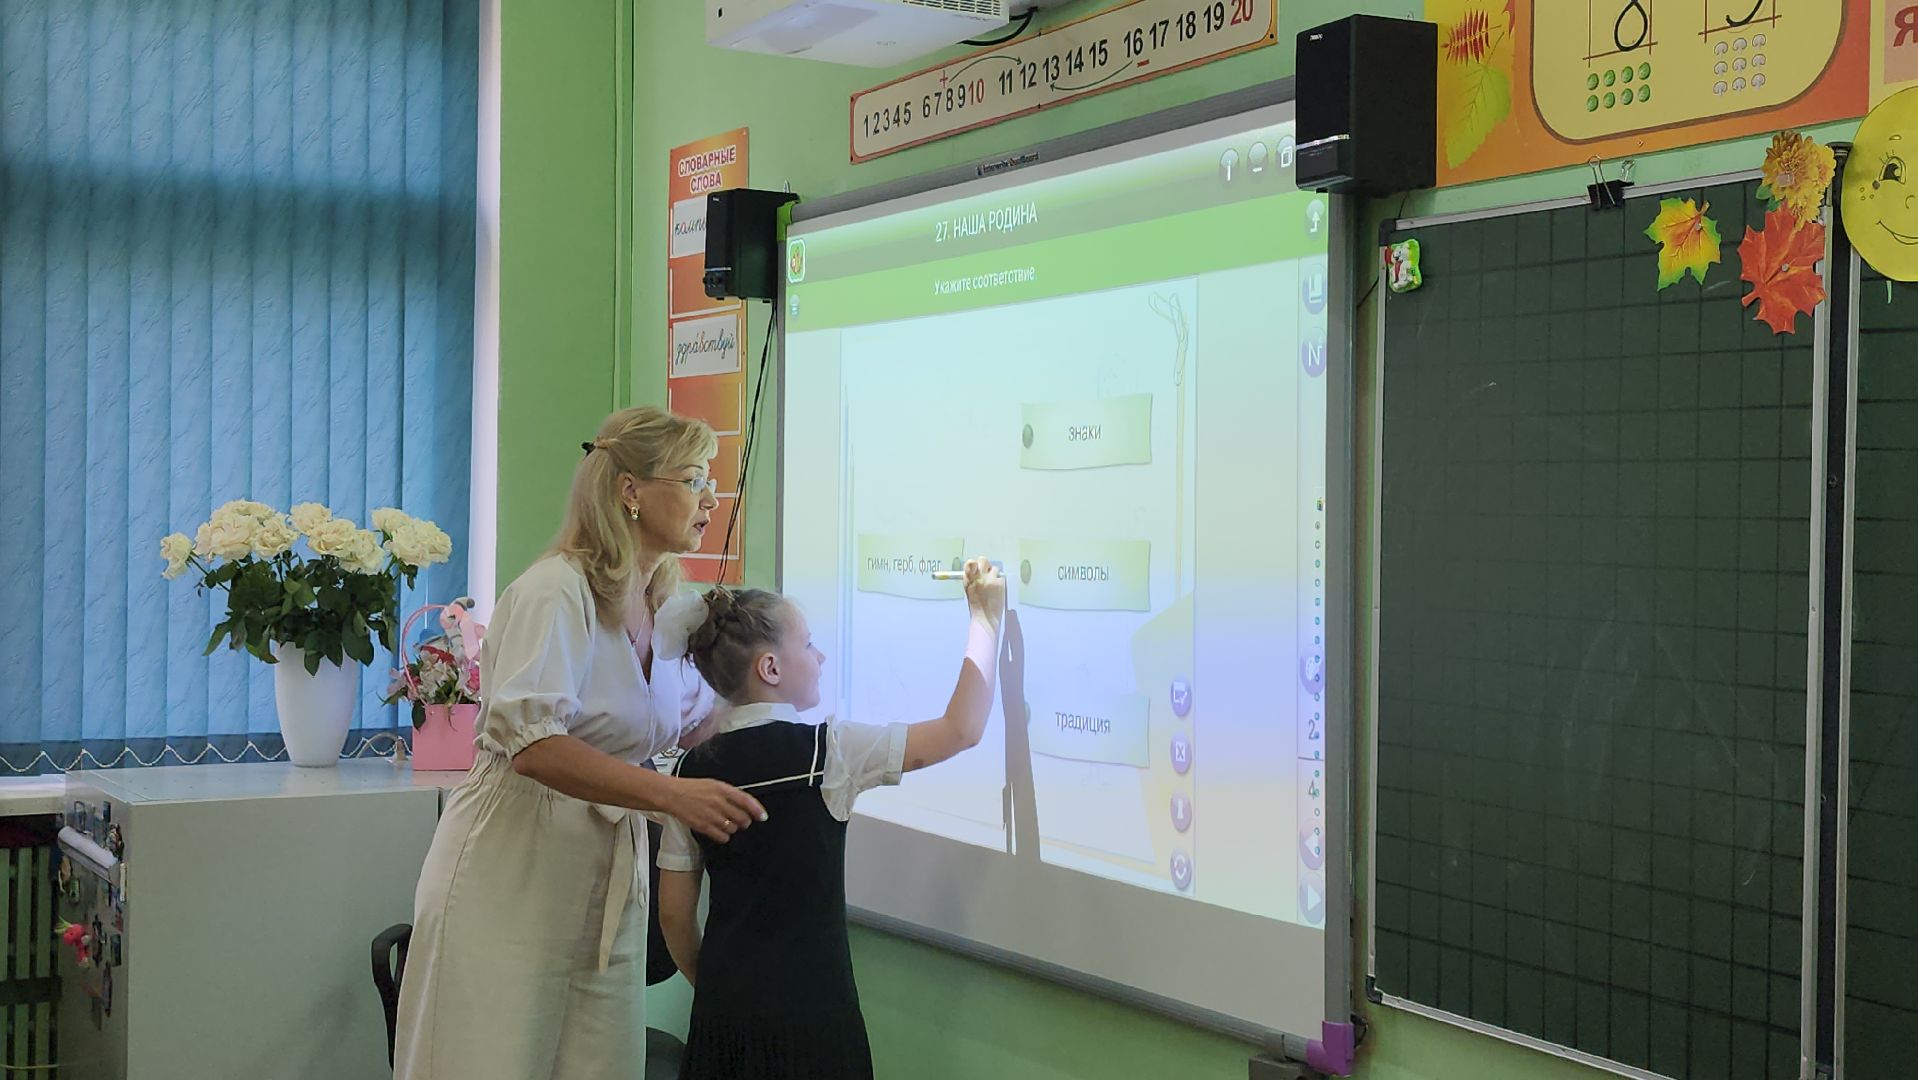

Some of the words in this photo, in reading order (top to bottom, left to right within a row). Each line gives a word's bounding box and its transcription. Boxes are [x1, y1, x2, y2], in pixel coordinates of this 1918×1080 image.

[968, 78, 985, 105] 10
[998, 69, 1013, 95] 11
[1019, 62, 1037, 90] 12
[1042, 55, 1060, 83] 13
[1065, 46, 1084, 76] 14
[1088, 39, 1108, 69] 15
[1123, 28, 1143, 58] 16
[1149, 20, 1169, 50] 17
[1175, 11, 1196, 42] 18
[1203, 2, 1225, 33] 19
[1230, 0, 1253, 26] 20
[679, 146, 736, 176] СЛОВАРНЫЕ
[690, 172, 722, 192] СЛОВА
[935, 221, 951, 242] 27.
[953, 213, 986, 239] НАША
[988, 201, 1038, 234] РОДИНА
[934, 277, 971, 296] Укажите
[972, 266, 1036, 290] соответствие
[1068, 424, 1101, 442] знаки
[867, 556, 891, 573] гимн,
[893, 555, 916, 575] герб,
[918, 555, 942, 576] флаг
[1057, 565, 1109, 581] символы
[1055, 711, 1111, 736] традиция
